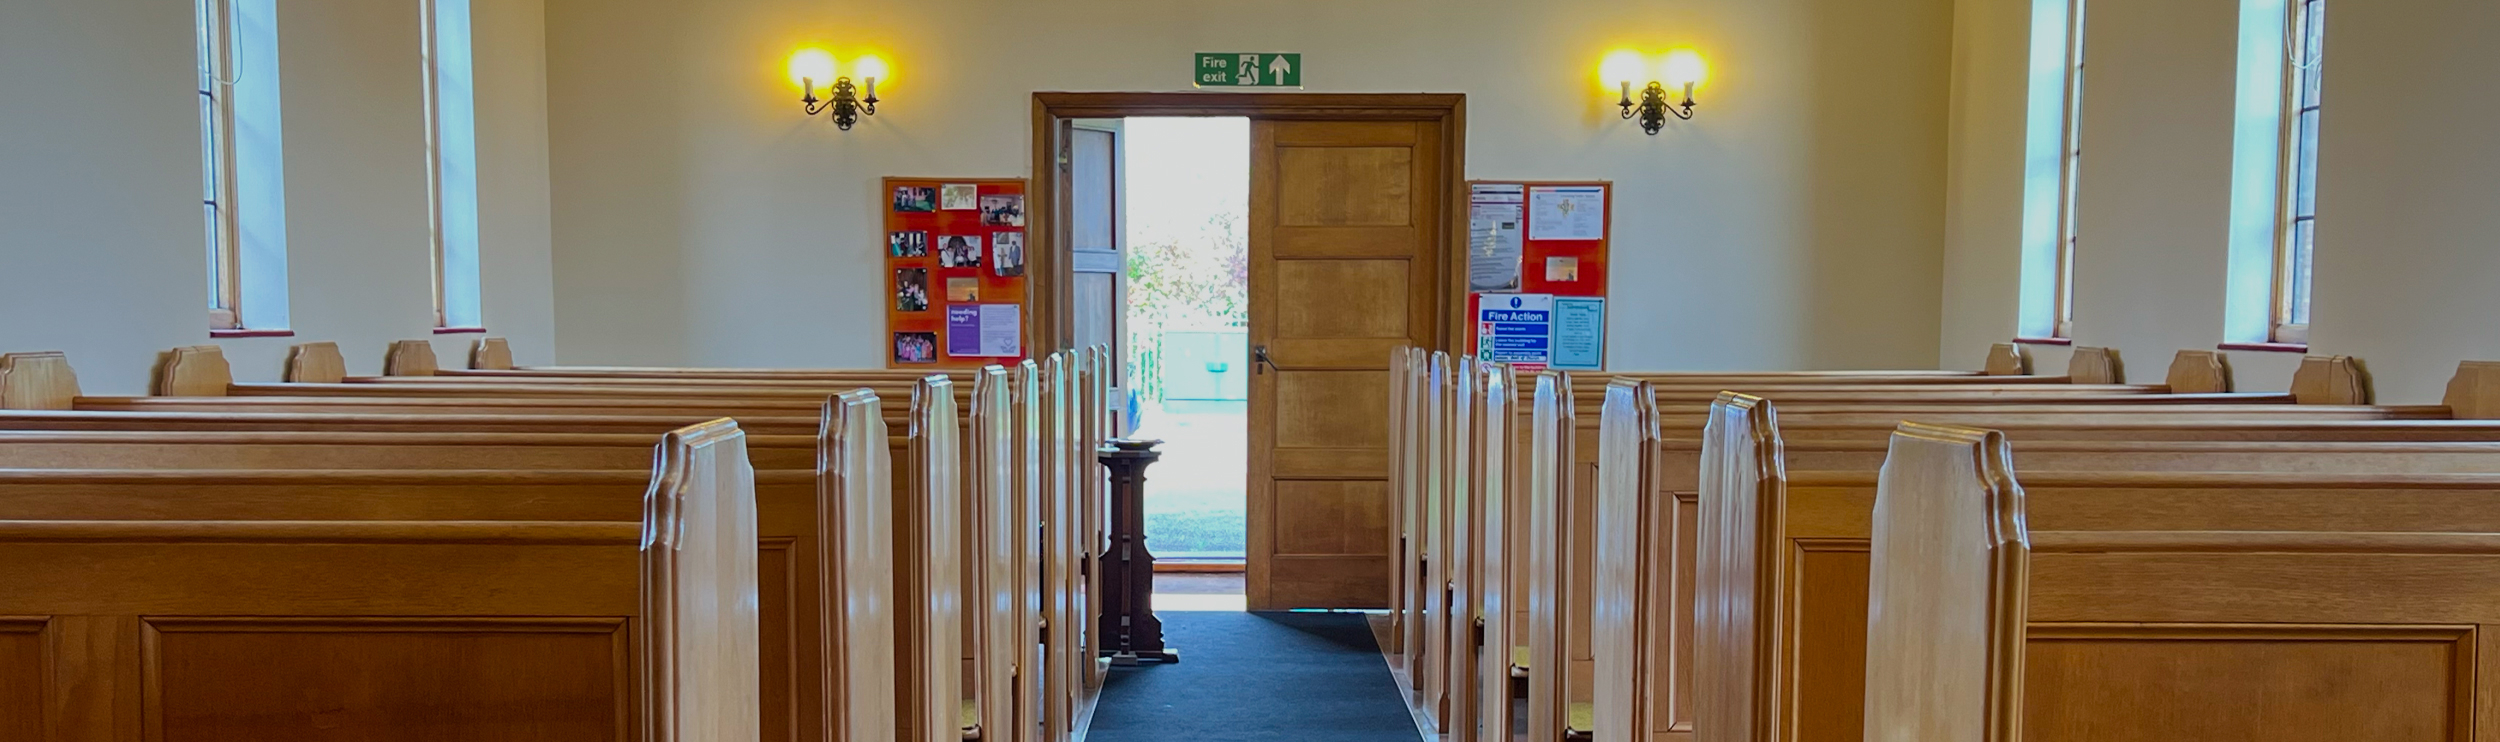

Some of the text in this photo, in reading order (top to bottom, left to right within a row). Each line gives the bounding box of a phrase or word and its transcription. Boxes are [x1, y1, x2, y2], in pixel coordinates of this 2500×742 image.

[1203, 57, 1227, 68] Fire
[1203, 71, 1227, 82] exit
[951, 315, 969, 323] help?
[1488, 311, 1543, 321] Fire Action
